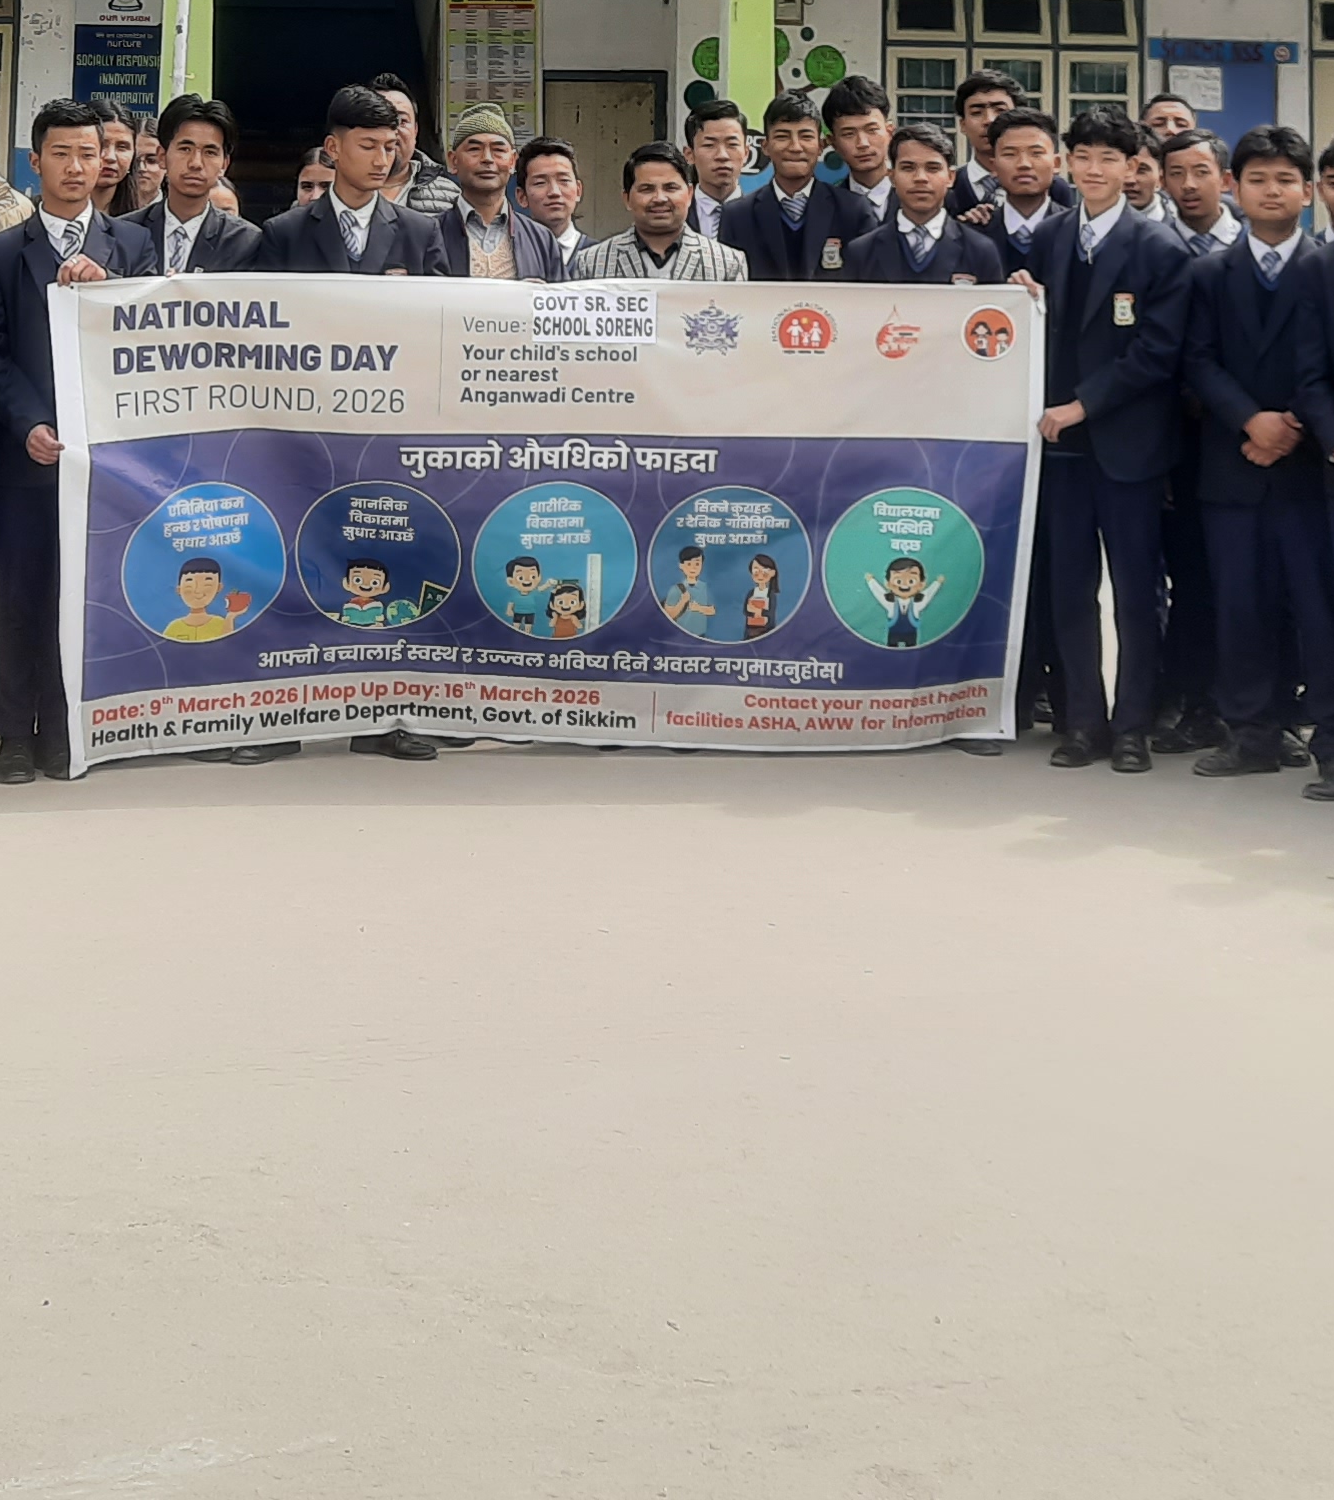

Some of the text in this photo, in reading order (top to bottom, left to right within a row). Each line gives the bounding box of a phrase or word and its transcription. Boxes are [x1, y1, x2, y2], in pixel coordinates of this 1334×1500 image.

[533, 296, 649, 312] GOVT SR. SEC
[113, 300, 290, 331] NATIONAL
[463, 316, 526, 333] Venue:
[533, 316, 654, 337] SCHOOL SORENG
[113, 342, 399, 375] DEWORMING DAY
[462, 344, 638, 362] Your child's school
[461, 367, 559, 382] or nearest
[116, 384, 406, 418] FIRST ROUND, 2026
[460, 387, 635, 406] Anganwadi Centre
[399, 437, 719, 479] जुकाको औषधिको फाइदा
[350, 496, 409, 512] मानसिक
[349, 509, 409, 528] विकासमा
[526, 514, 584, 530] विकासमा
[342, 525, 377, 541] सुधार
[520, 532, 555, 549] सुधार
[258, 643, 320, 668] आफ्नो
[323, 639, 407, 663] बच्चालाई
[407, 646, 458, 662] स्वस्थ
[462, 647, 474, 663] र
[548, 650, 609, 671] भविष्य
[612, 651, 649, 671] दिने
[653, 654, 712, 674] अवसर
[92, 681, 601, 725] Date: 9th March 2026 Mop Up Day: 16th March 2026
[744, 684, 988, 714] Contact your nearest health
[91, 701, 637, 748] Health & Family Welfare Department, Govt. of Sikkim
[666, 704, 987, 732] facilities ASHA, AWW for information
